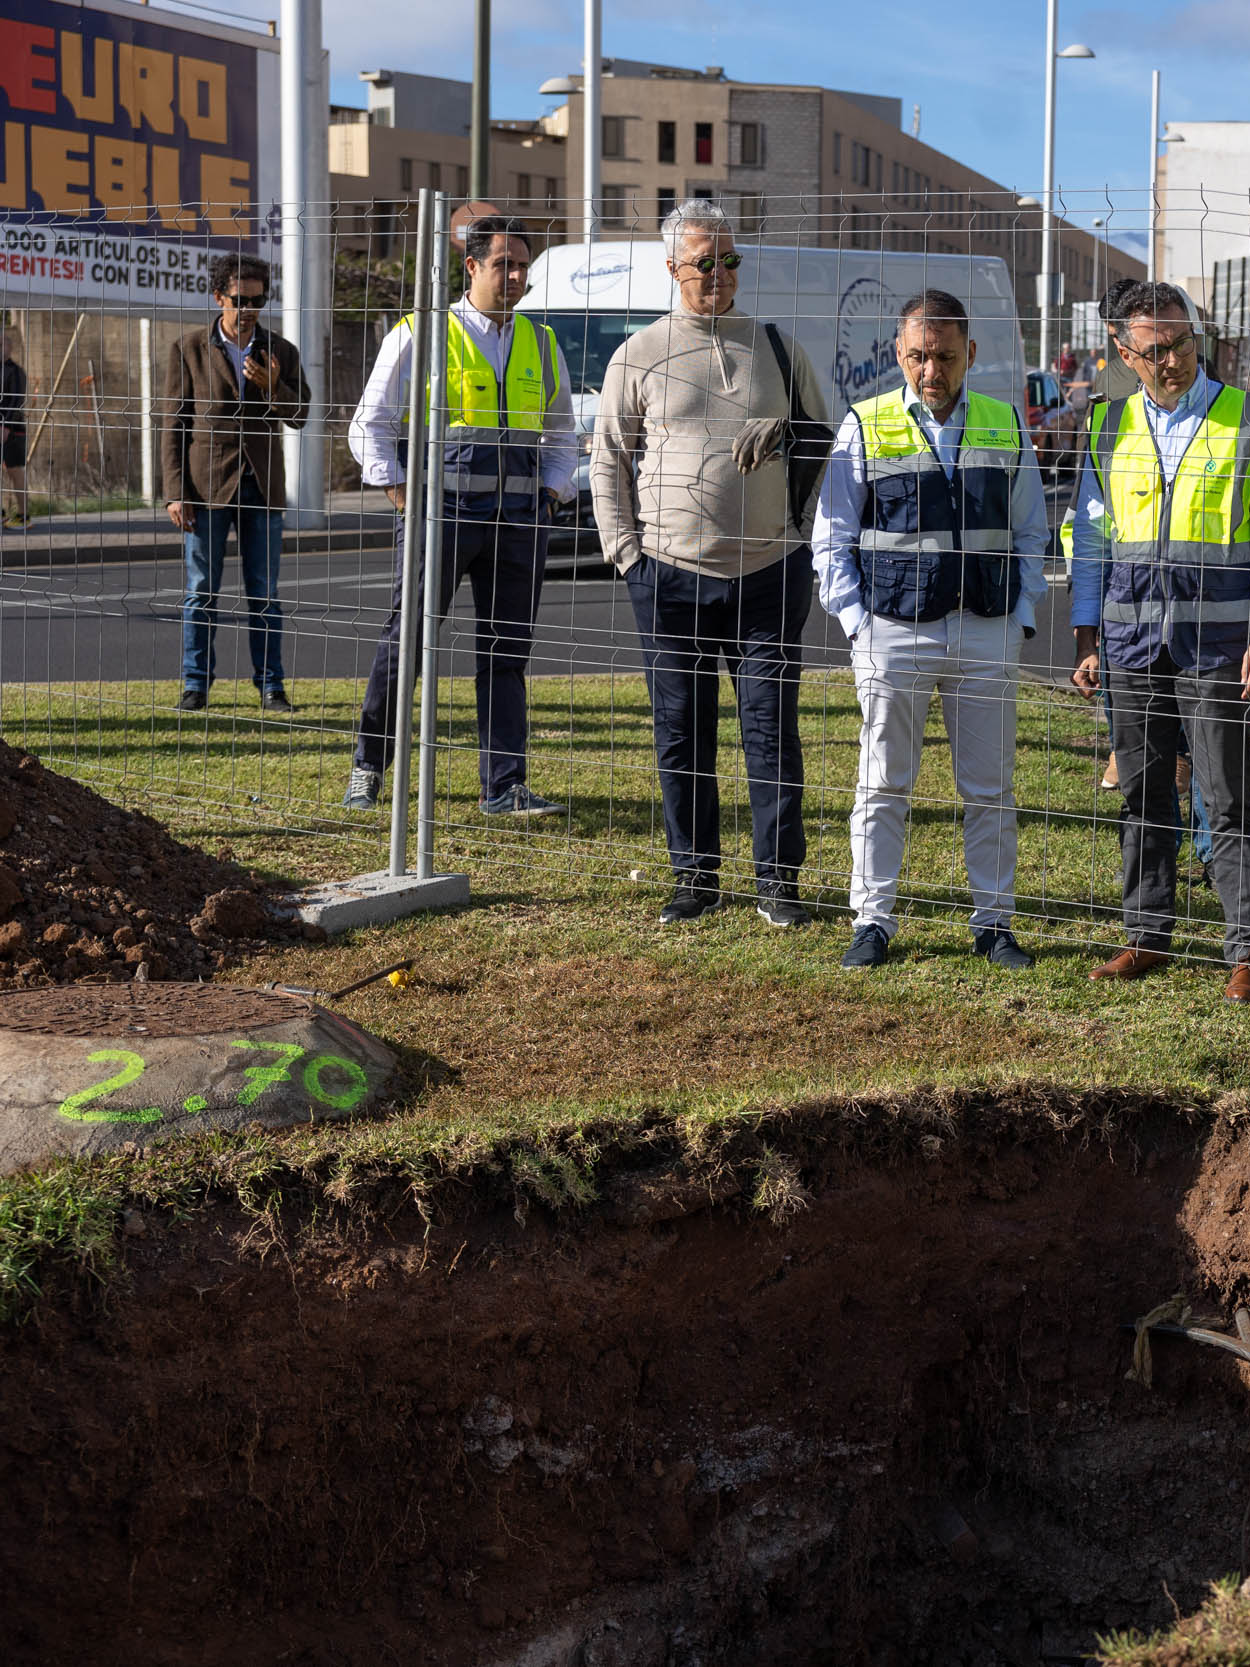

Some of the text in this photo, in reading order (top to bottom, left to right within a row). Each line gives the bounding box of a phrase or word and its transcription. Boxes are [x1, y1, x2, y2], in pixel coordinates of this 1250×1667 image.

[0, 18, 228, 145] EURO
[55, 232, 160, 267] ARTÍCULOS
[168, 248, 191, 270] DE
[92, 263, 129, 286] CON
[137, 268, 210, 295] ENTREG
[58, 1039, 369, 1124] 2.70
